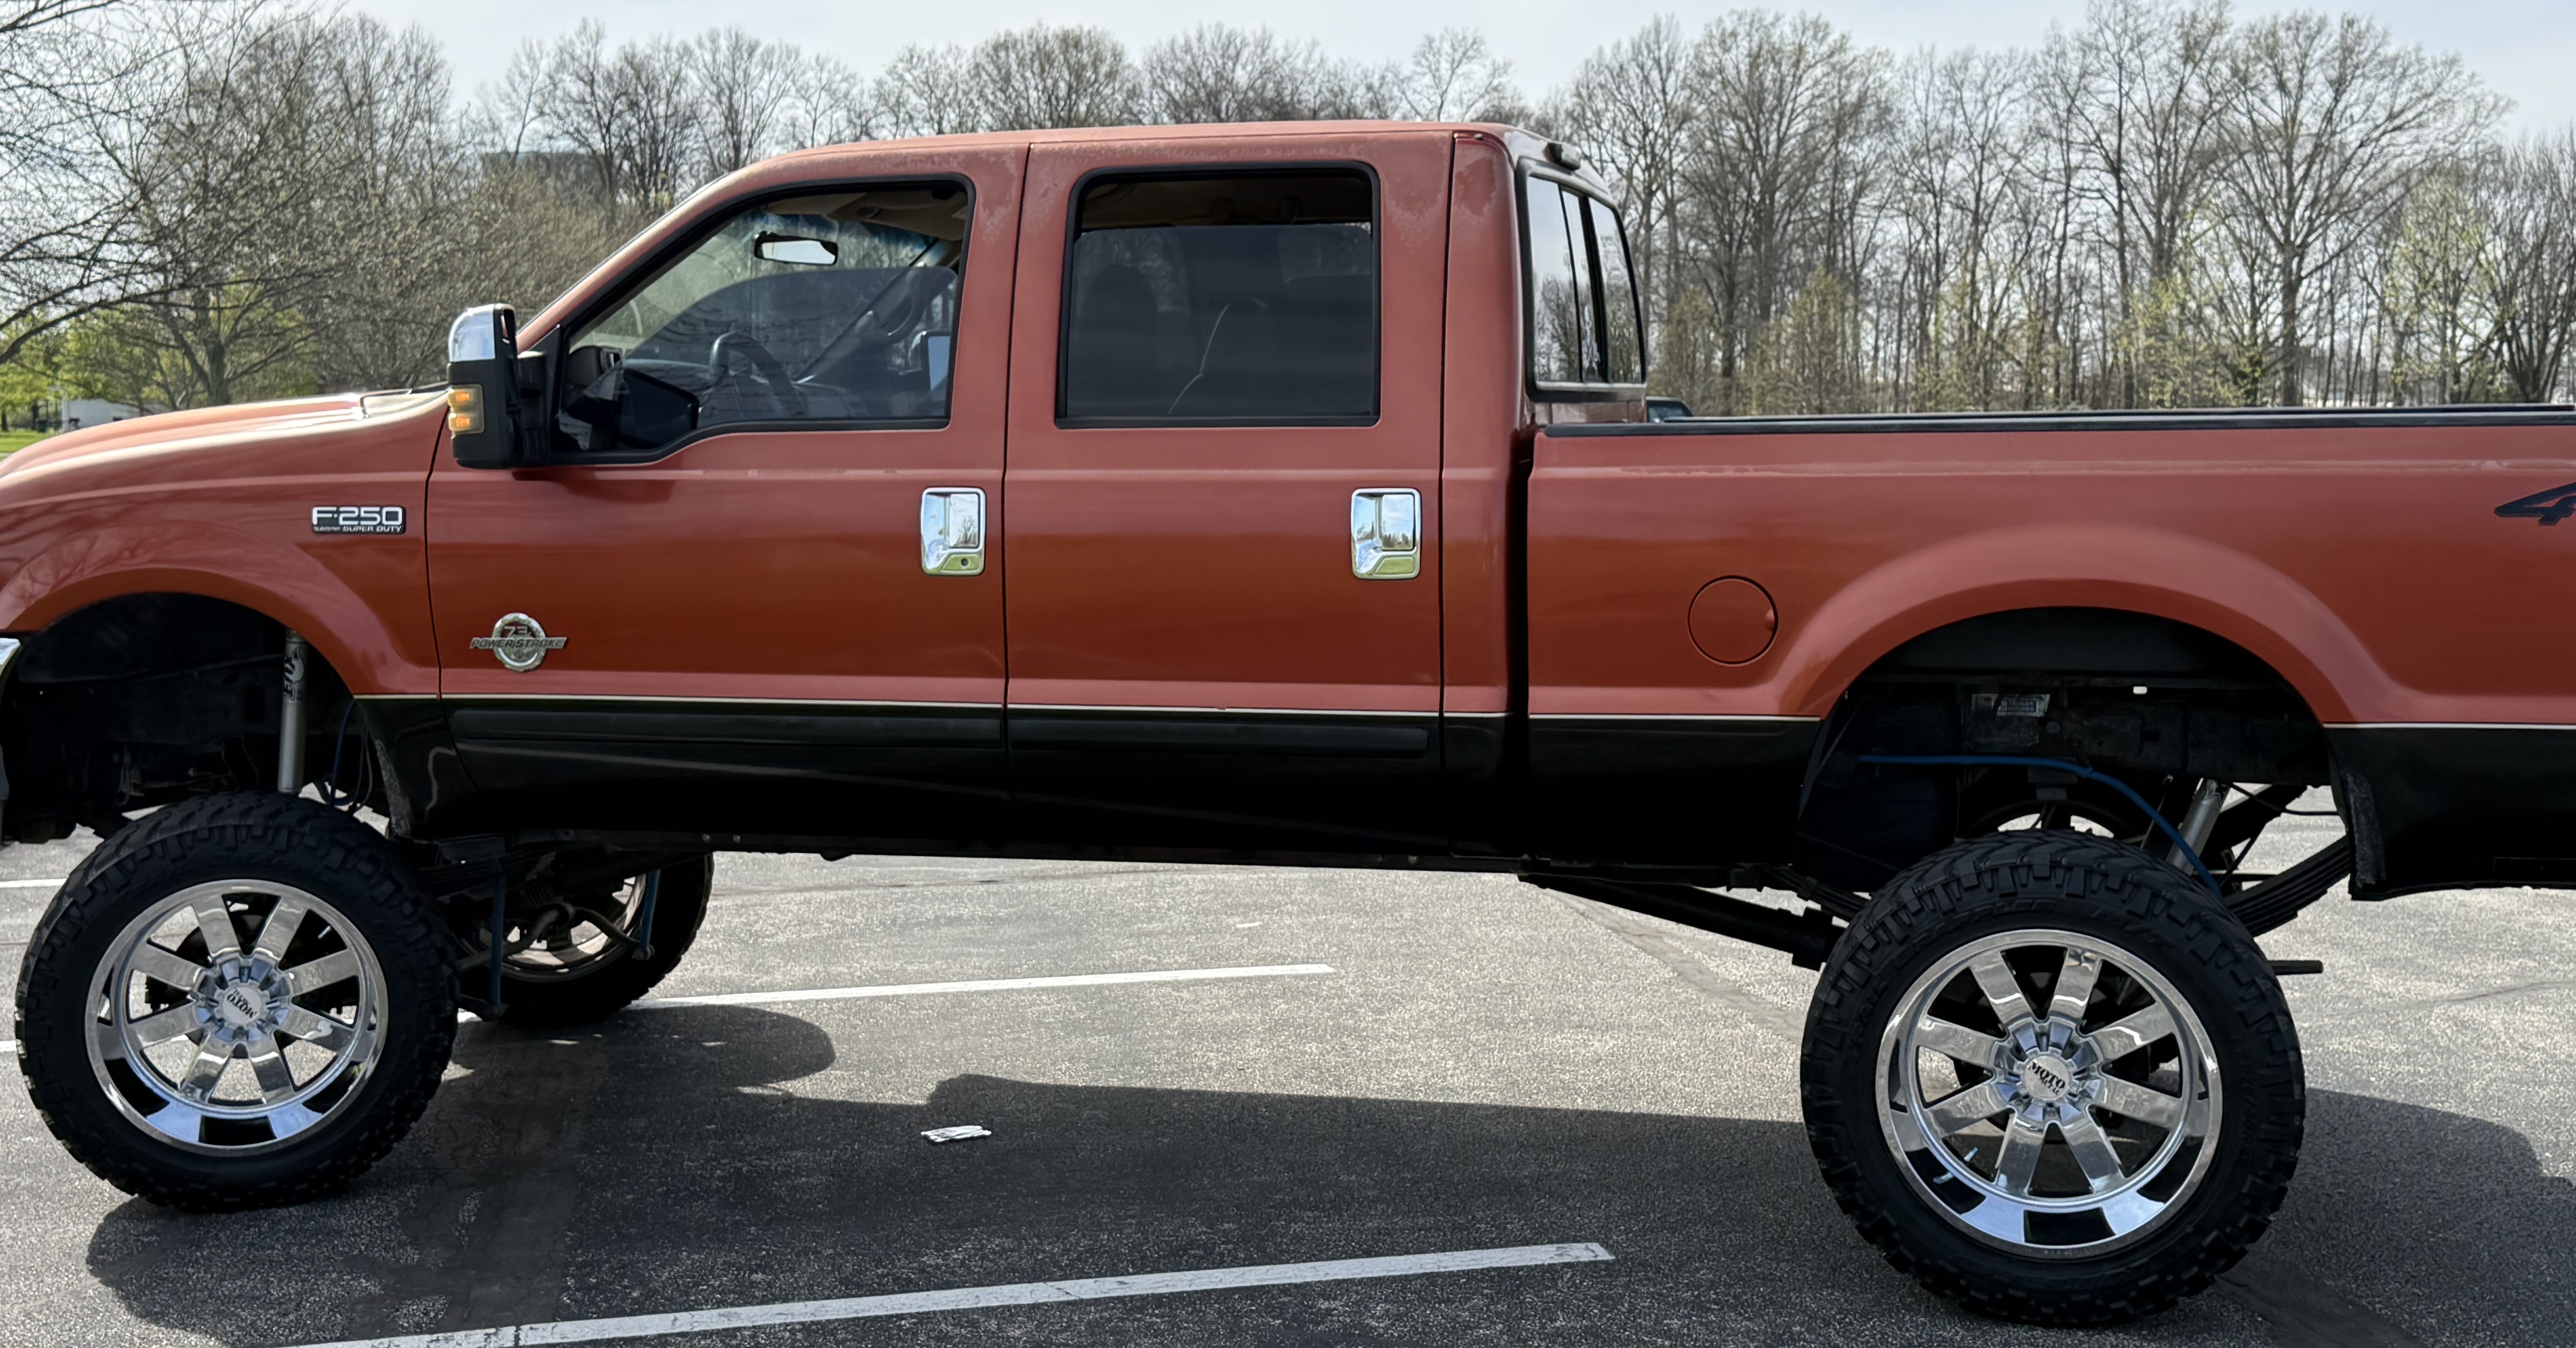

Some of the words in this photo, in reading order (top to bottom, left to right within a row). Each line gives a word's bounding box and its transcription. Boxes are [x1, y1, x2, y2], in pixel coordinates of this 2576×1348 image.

[472, 639, 514, 648] POWER
[227, 994, 258, 1018] MOTO
[2028, 1062, 2065, 1089] MOTO
